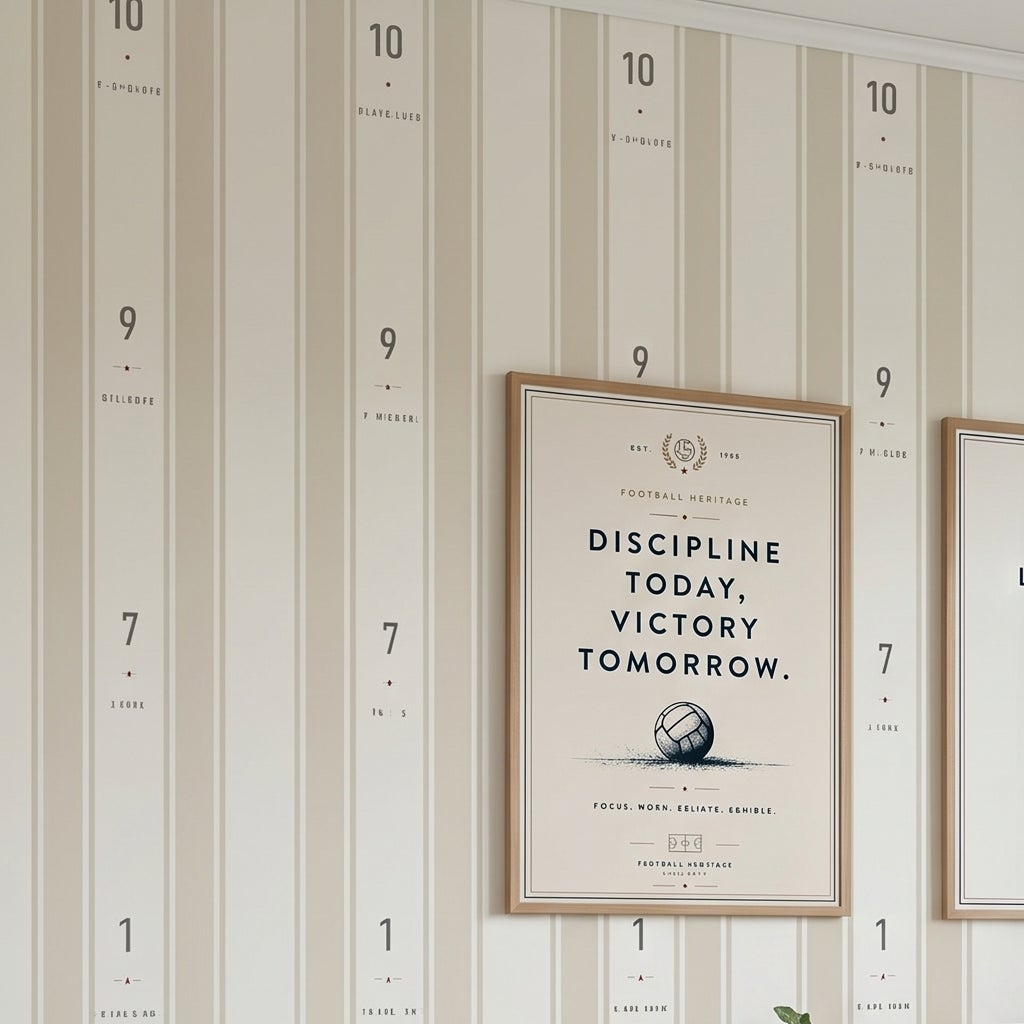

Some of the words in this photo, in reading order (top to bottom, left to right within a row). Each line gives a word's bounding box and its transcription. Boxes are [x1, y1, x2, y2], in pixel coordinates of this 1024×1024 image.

[109, 0, 143, 31] 10
[370, 23, 403, 59] 10
[622, 51, 655, 87] 10
[866, 80, 897, 115] 10
[119, 306, 137, 341] 9
[380, 327, 397, 360] 9
[633, 345, 648, 379] 9
[876, 366, 891, 399] 9
[620, 488, 683, 501] FOOTBALL
[689, 494, 748, 507] HERITAGE
[589, 528, 780, 564] DISCIPLINE
[625, 570, 746, 604] TODAY,
[122, 611, 139, 646] 7
[382, 621, 399, 655] 7
[610, 609, 758, 640] VICTORY
[578, 647, 789, 681] TOMORROW.
[878, 642, 893, 675] 7
[593, 802, 633, 811] FOCUS.
[118, 917, 131, 953] 1
[379, 917, 391, 952] 1
[632, 917, 645, 951] 1
[875, 918, 886, 951] 1
